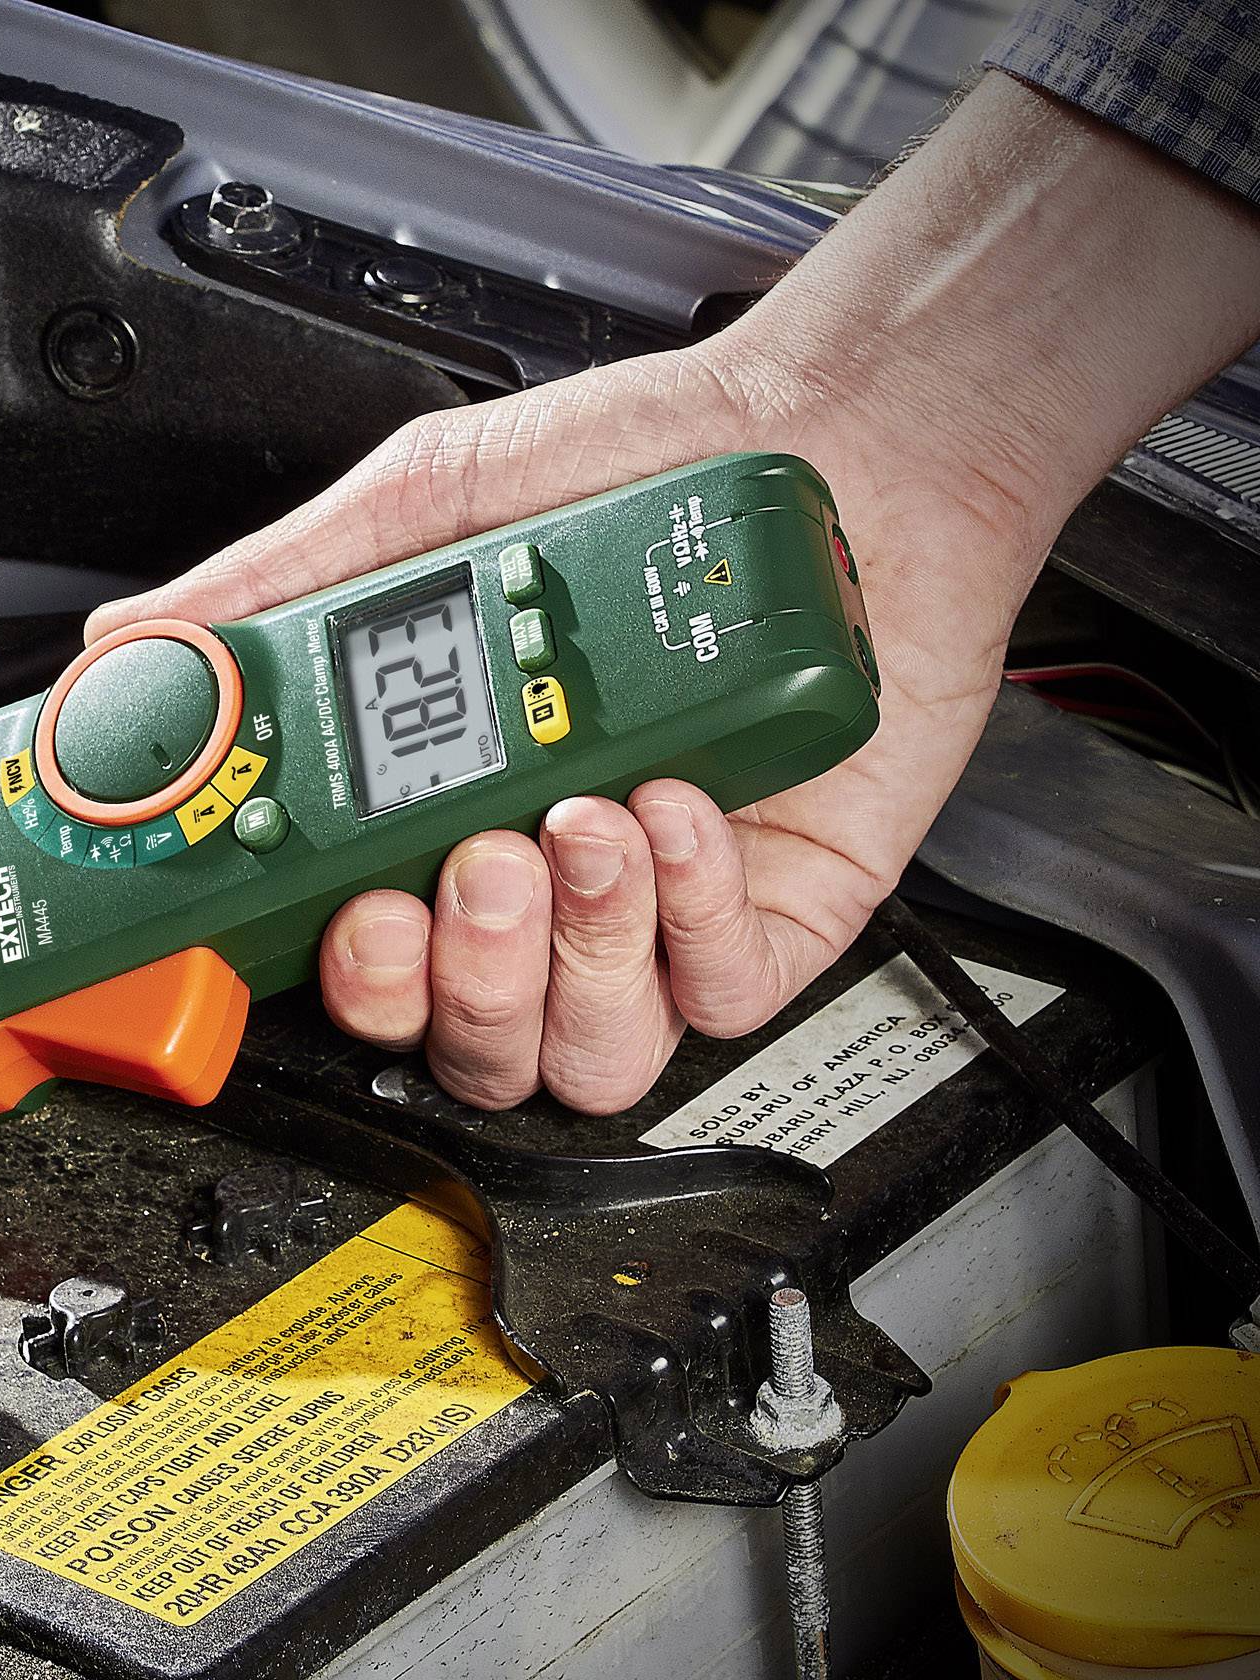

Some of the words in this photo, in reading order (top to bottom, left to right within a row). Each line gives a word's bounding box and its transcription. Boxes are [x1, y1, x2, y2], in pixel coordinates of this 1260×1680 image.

[504, 557, 517, 581] REL
[516, 548, 533, 579] ZERO
[643, 566, 662, 595] 600V
[307, 618, 320, 654] Meter
[513, 625, 527, 652] MAX
[527, 619, 543, 645] MIN
[652, 609, 670, 633] CAT
[689, 612, 719, 662] COM
[314, 656, 328, 695] Clamp
[253, 713, 273, 741] OFF
[317, 697, 335, 736] AC/DC
[5, 759, 22, 785] NCV
[322, 739, 340, 770] 400A
[21, 798, 38, 830] Hz%
[329, 772, 346, 811] TRMS
[60, 825, 73, 858] Temp
[8, 865, 24, 919] INSTRUMENTS
[32, 900, 53, 945] MA445
[716, 1094, 792, 1147] SUBARU
[792, 1074, 818, 1091] OF
[823, 1016, 907, 1071] AMERICA
[758, 1111, 816, 1151] UBARU
[813, 1073, 872, 1107] PLAZA
[909, 1011, 957, 1038] BOX
[689, 1105, 741, 1139] SOLD
[740, 1082, 770, 1101] BY
[787, 1119, 837, 1158] HERRY
[838, 1091, 886, 1116] HILL,
[882, 1068, 916, 1085] NJ.
[51, 1459, 99, 1489] flames
[95, 1449, 112, 1460] or
[111, 1422, 155, 1450] sparks
[151, 1398, 188, 1423] could
[185, 1376, 223, 1400] cause
[216, 1346, 269, 1376] battery
[262, 1337, 282, 1347] to
[279, 1307, 332, 1338] explode.
[327, 1274, 375, 1305] Always
[1, 1514, 42, 1542] shield
[40, 1494, 74, 1516] eyes
[71, 1476, 98, 1495] and
[93, 1459, 126, 1478] face
[122, 1438, 158, 1460] from
[151, 1407, 206, 1439] battery.
[198, 1394, 222, 1407] Do
[219, 1379, 245, 1395] not
[241, 1353, 285, 1380] charge
[281, 1342, 299, 1353] or
[296, 1329, 322, 1344] use
[315, 1298, 364, 1330] booster
[362, 1273, 403, 1299] cables
[33, 1511, 75, 1539] adjust
[72, 1492, 104, 1514] post
[101, 1444, 175, 1492] connections
[171, 1412, 223, 1444] without
[219, 1385, 260, 1414] proper
[259, 1344, 326, 1386] instruction
[322, 1327, 349, 1345] and
[342, 1297, 400, 1329] training.
[61, 1399, 149, 1455] EXPLOSIVE
[140, 1367, 197, 1402] GASES
[34, 1530, 80, 1561] KEEP
[74, 1502, 124, 1532] VENT
[116, 1475, 166, 1505] CAPS
[154, 1443, 210, 1476] TIGHT
[203, 1422, 244, 1448] AND
[234, 1393, 291, 1424] LEVEL
[65, 1504, 177, 1575] POISON
[172, 1463, 240, 1505] CAUSES
[231, 1424, 296, 1464] SEVERE
[286, 1391, 345, 1426] BURNS
[95, 1546, 155, 1584] Contains
[152, 1513, 203, 1547] sulfuric
[196, 1494, 234, 1514] acid.
[229, 1466, 269, 1494] Avoid
[267, 1436, 315, 1468] contact
[310, 1417, 344, 1436] with
[341, 1398, 376, 1417] skin,
[370, 1378, 402, 1398] eyes
[398, 1369, 415, 1379] or
[413, 1336, 467, 1370] clothing.
[115, 1578, 133, 1591] of
[131, 1543, 187, 1580] accident
[181, 1521, 219, 1543] flush
[215, 1500, 250, 1520] with
[246, 1474, 286, 1500] water
[285, 1455, 312, 1474] and
[309, 1439, 335, 1457] call
[343, 1396, 402, 1435] physician
[399, 1346, 478, 1396] immediately.
[130, 1571, 177, 1602] KEEP
[172, 1547, 213, 1573] OUT
[205, 1532, 233, 1551] OF
[226, 1498, 288, 1536] REACH
[278, 1481, 307, 1500] OF
[300, 1431, 383, 1485] CHILDREN
[163, 1573, 234, 1617] 20HR
[223, 1538, 287, 1576] 48Ah
[279, 1500, 341, 1535] CCA
[326, 1465, 392, 1502] 390A
